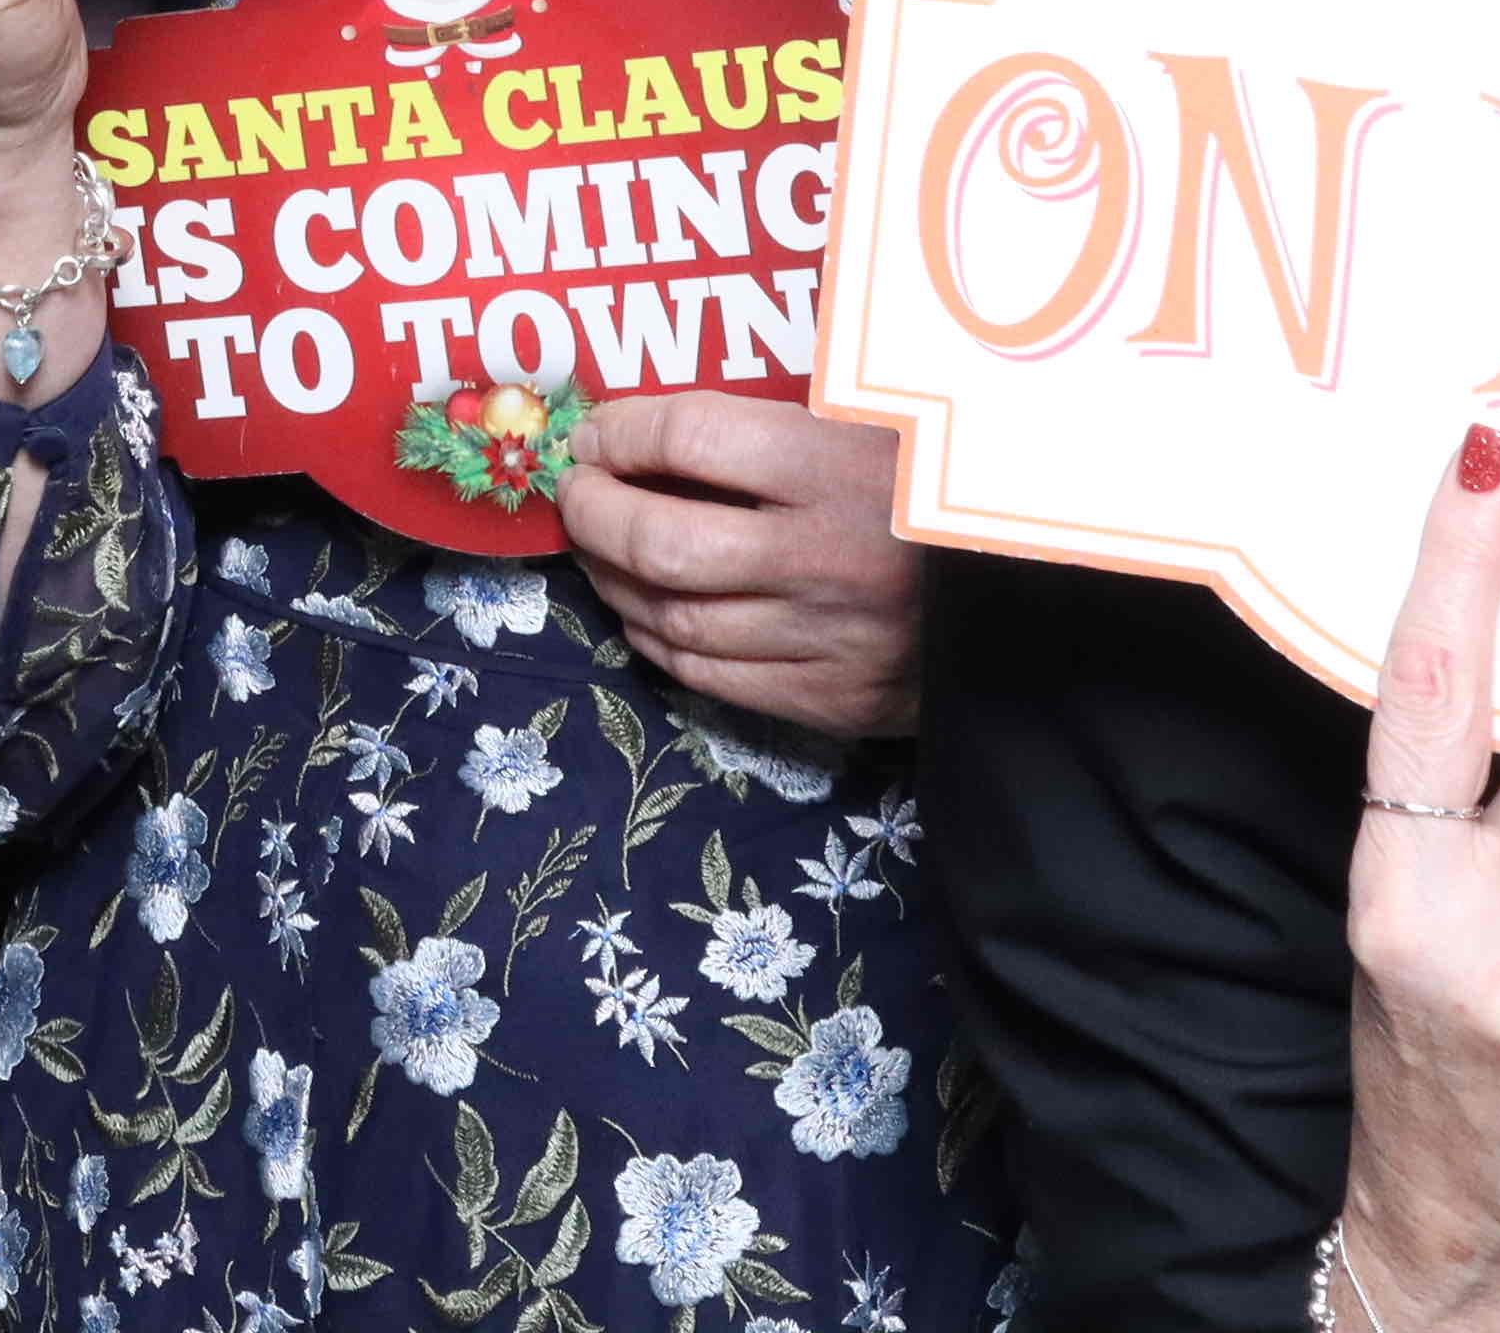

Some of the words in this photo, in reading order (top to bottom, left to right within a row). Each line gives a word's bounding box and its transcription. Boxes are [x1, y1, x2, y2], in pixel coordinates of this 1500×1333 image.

[87, 80, 462, 187] SANTA
[483, 37, 843, 151] CLAUS
[111, 197, 244, 308] IS
[273, 141, 837, 294] COMING
[917, 50, 1403, 389] ON
[165, 307, 355, 419] TO
[380, 267, 819, 403] TOWN
